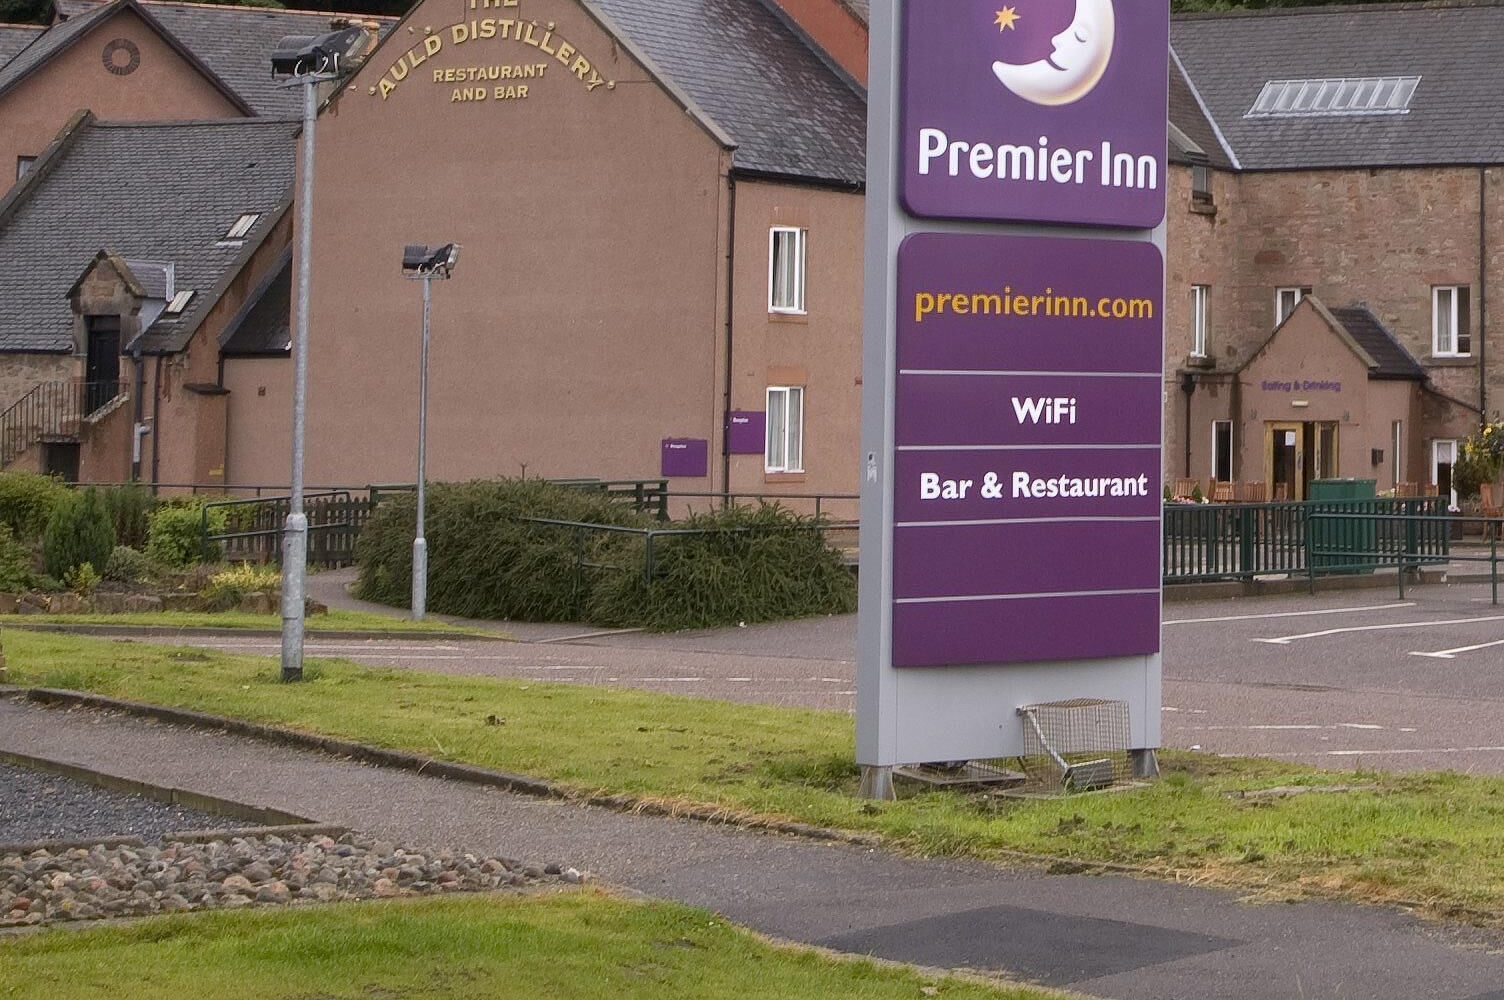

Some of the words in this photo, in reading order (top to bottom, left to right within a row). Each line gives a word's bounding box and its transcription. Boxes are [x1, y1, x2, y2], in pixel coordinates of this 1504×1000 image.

[378, 34, 442, 100] AULD
[451, 18, 605, 92] DISTILLERY
[432, 63, 548, 83] RESTAURANT
[451, 87, 488, 102] AND
[494, 84, 529, 100] BAR
[918, 127, 1094, 184] Premier
[1101, 141, 1157, 190] Inn
[914, 286, 1153, 323] premierinn.com
[1011, 397, 1076, 424] WiFi
[920, 472, 973, 500] Bar
[981, 471, 1003, 499] &
[1012, 471, 1148, 499] Restaurant
